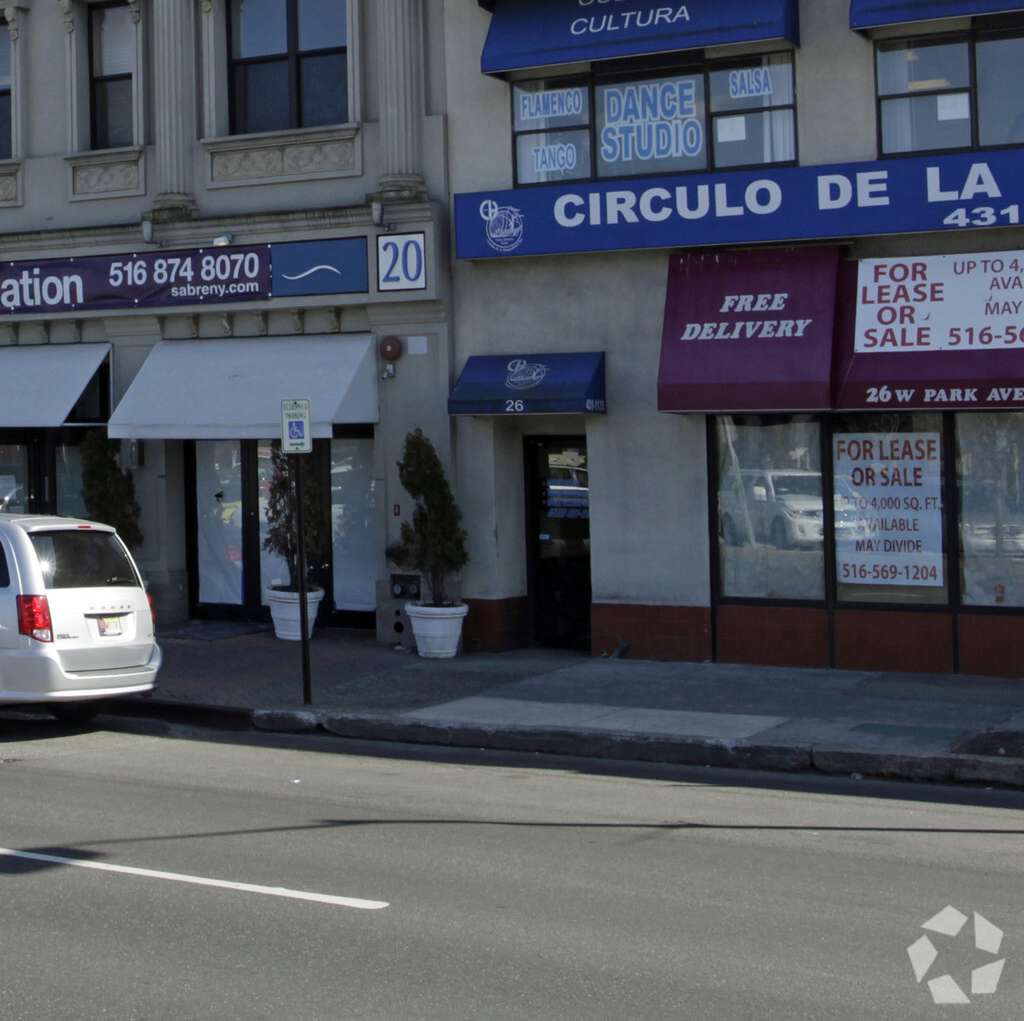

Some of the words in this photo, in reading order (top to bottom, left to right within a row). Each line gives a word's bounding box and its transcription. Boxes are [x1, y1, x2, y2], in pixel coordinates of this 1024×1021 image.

[570, 4, 690, 36] CULTURA
[729, 67, 773, 99] SALSA
[520, 87, 582, 120] FLAMENCO
[604, 79, 697, 125] DANCE
[600, 117, 704, 163] STUDIO
[532, 143, 576, 173] TANGO
[553, 178, 783, 228] CIRCULO
[817, 170, 890, 210] DE
[926, 162, 1002, 203] LA
[942, 204, 1020, 227] 431
[108, 260, 148, 287] 516
[153, 256, 194, 284] 874
[201, 251, 260, 281] 8070
[381, 239, 422, 283] 20
[953, 260, 976, 275] UP
[981, 258, 1004, 274] TO
[874, 262, 928, 283] FOR
[171, 280, 260, 298] sabreny.com
[861, 282, 944, 304] LEASE
[989, 276, 1023, 291] AVA
[719, 293, 789, 313] FREE
[984, 300, 1022, 316] MAY
[877, 305, 915, 325] OR
[680, 318, 812, 341] DELIVERY
[864, 327, 930, 348] SALE
[866, 385, 892, 403] 26
[895, 389, 916, 403] W
[923, 388, 978, 402] PARK
[986, 388, 1024, 402] AVE
[283, 403, 308, 411] RESERVED
[505, 399, 524, 412] 26
[836, 439, 874, 461] FOR
[879, 439, 937, 461] LEASE
[851, 467, 876, 487] OR
[880, 467, 923, 487] SALE
[854, 497, 868, 510] TO
[871, 496, 901, 512] 4,000
[904, 496, 923, 512] SQ.
[925, 497, 942, 510] FT.
[858, 518, 919, 532] AVAILABLE
[855, 540, 880, 552] MAY
[884, 540, 922, 553] DIVIDE
[842, 563, 937, 581] 516-569-1204
